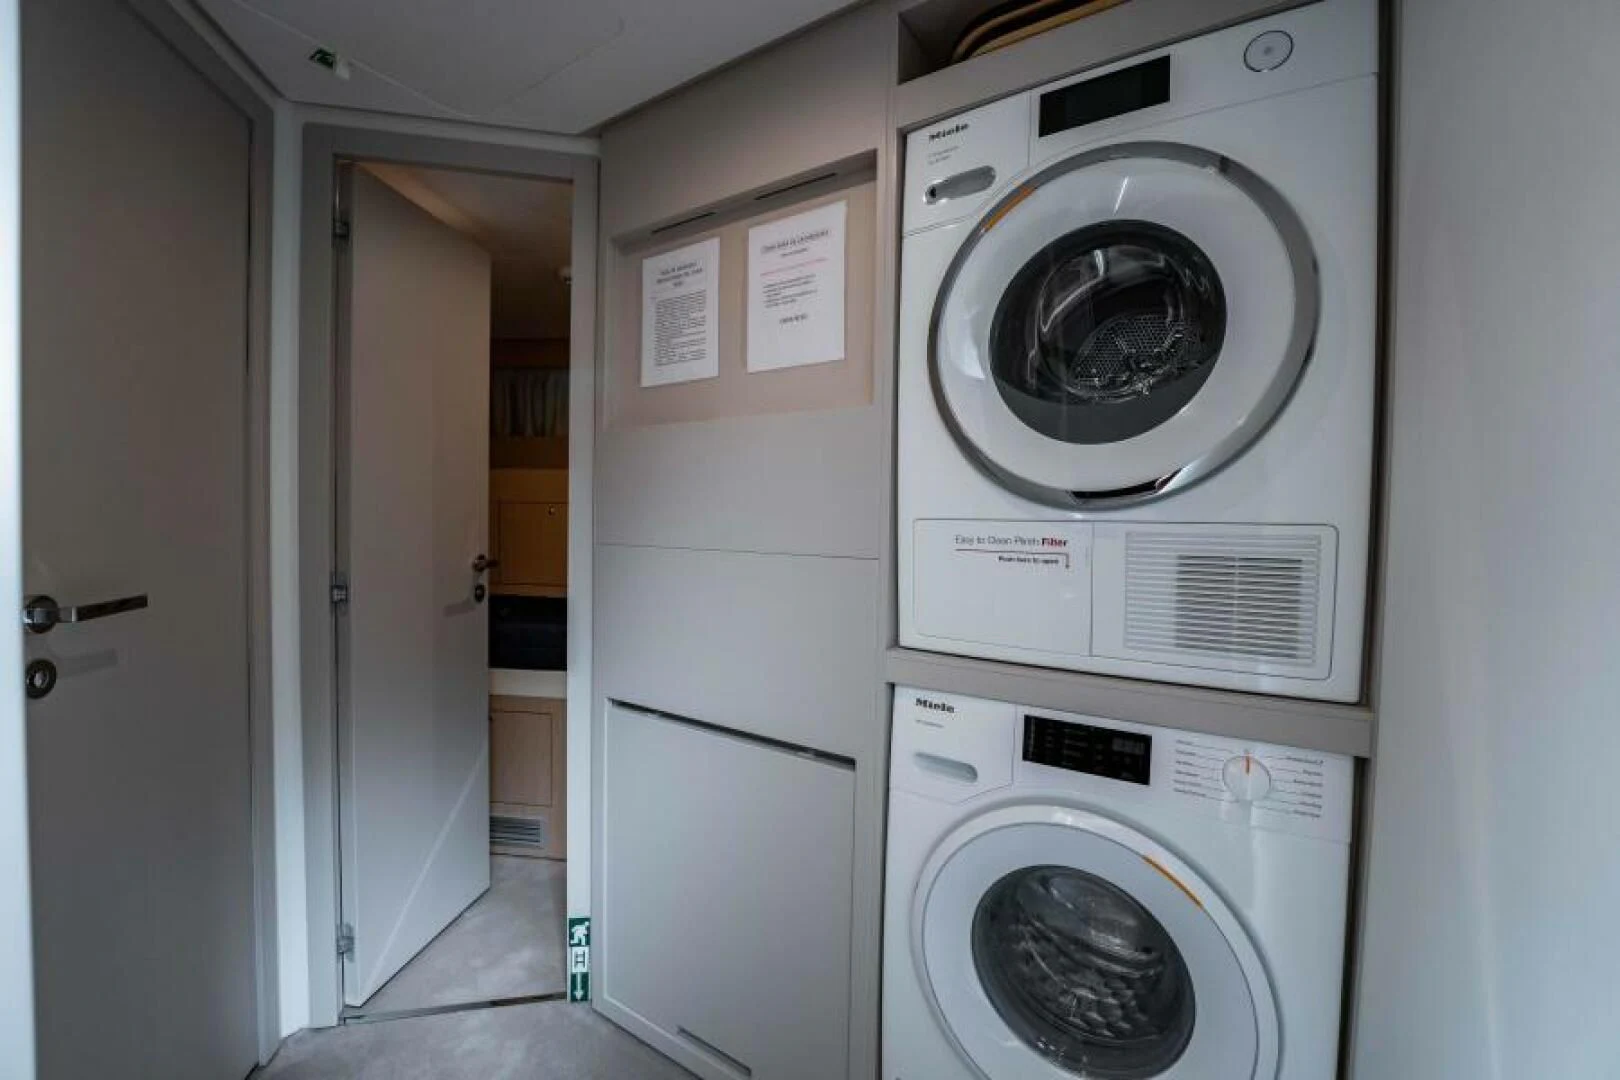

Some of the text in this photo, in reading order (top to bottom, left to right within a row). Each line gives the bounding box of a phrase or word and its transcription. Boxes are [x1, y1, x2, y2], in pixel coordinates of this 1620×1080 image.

[929, 123, 969, 140] Miele
[1041, 537, 1068, 547] Filter
[915, 697, 955, 714] Miele
